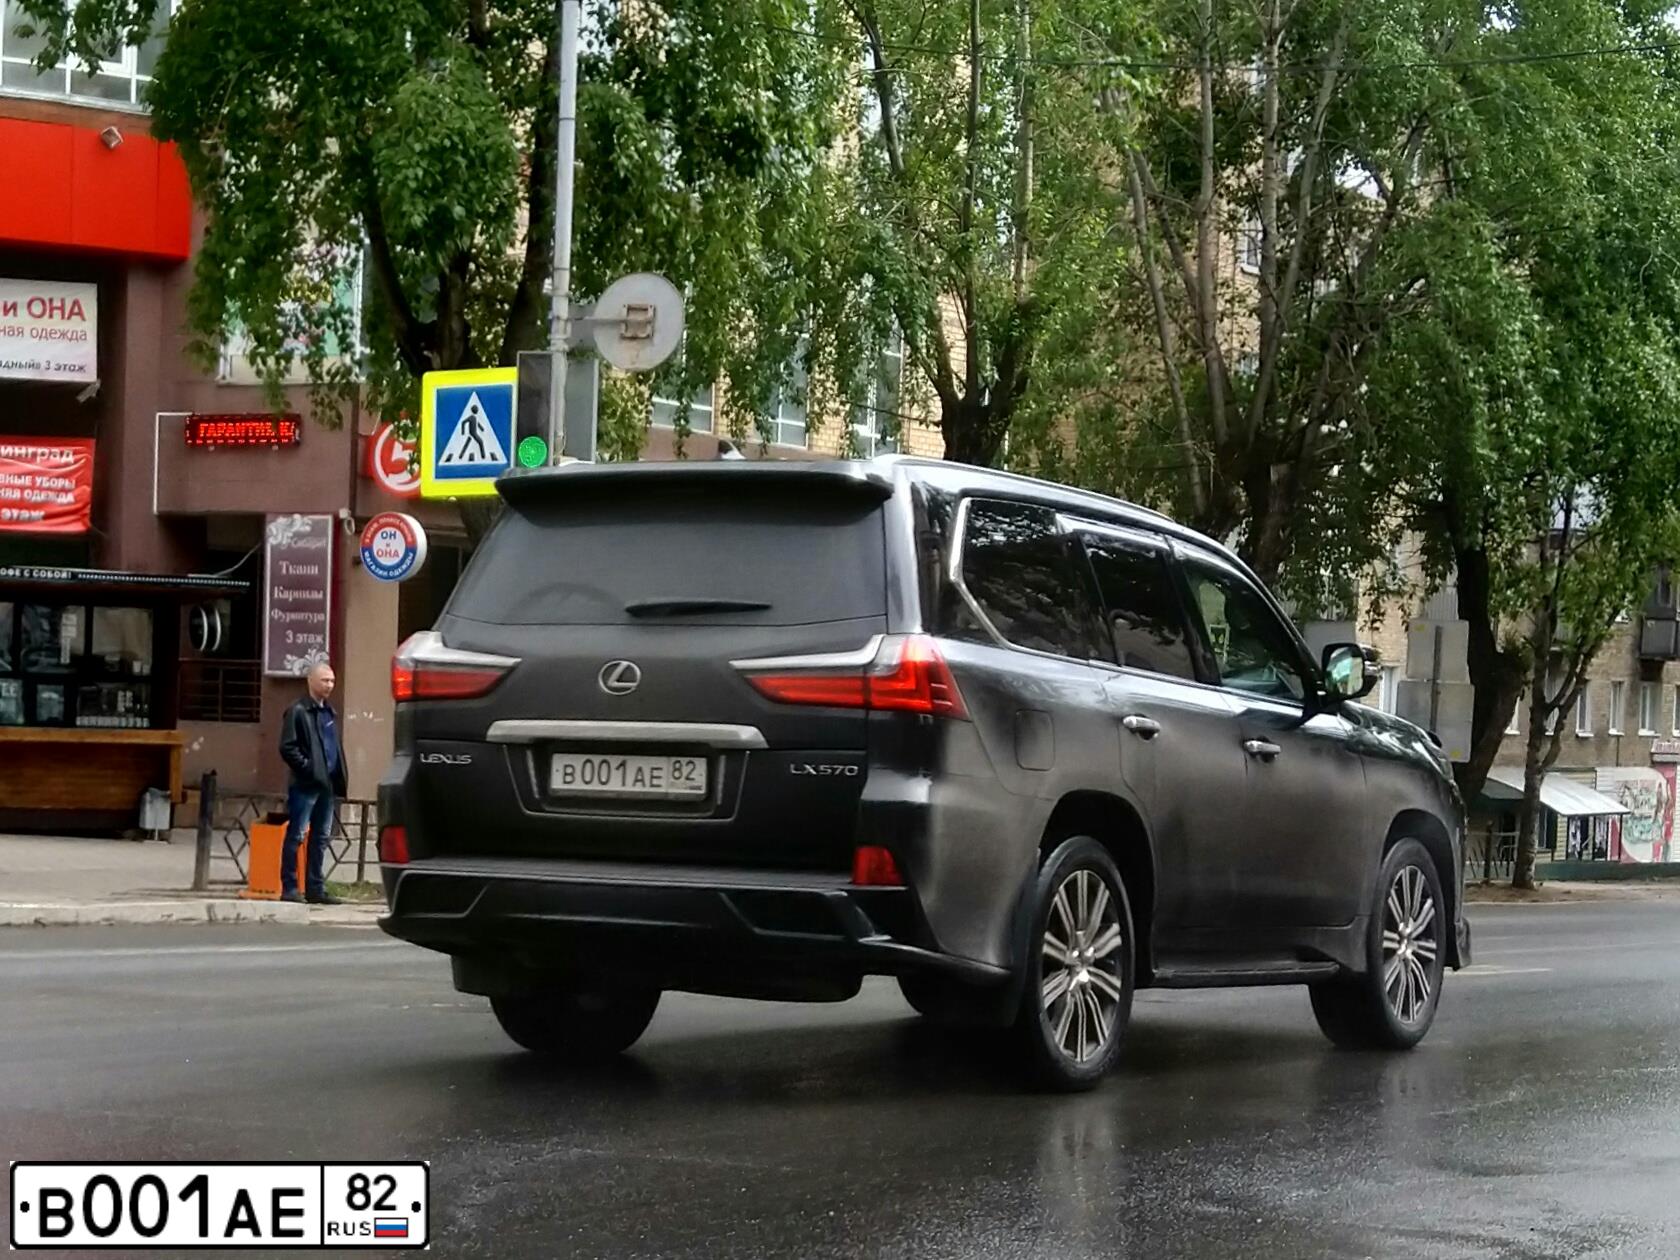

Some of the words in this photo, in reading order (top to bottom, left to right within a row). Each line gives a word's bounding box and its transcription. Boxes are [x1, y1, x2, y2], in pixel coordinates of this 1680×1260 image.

[2, 300, 18, 317] и
[26, 296, 86, 321] ОНА
[30, 326, 88, 342] одежда
[44, 360, 51, 370] 3
[54, 363, 87, 373] этаж
[381, 530, 397, 540] ОН
[376, 549, 400, 558] ОНА
[279, 561, 319, 575] Ткани
[273, 586, 324, 602] Карнизы
[271, 608, 325, 623] Фурнитура
[285, 630, 294, 644] 3
[295, 633, 324, 644] этаж
[420, 752, 472, 765] LEXUS
[671, 760, 697, 781] 82
